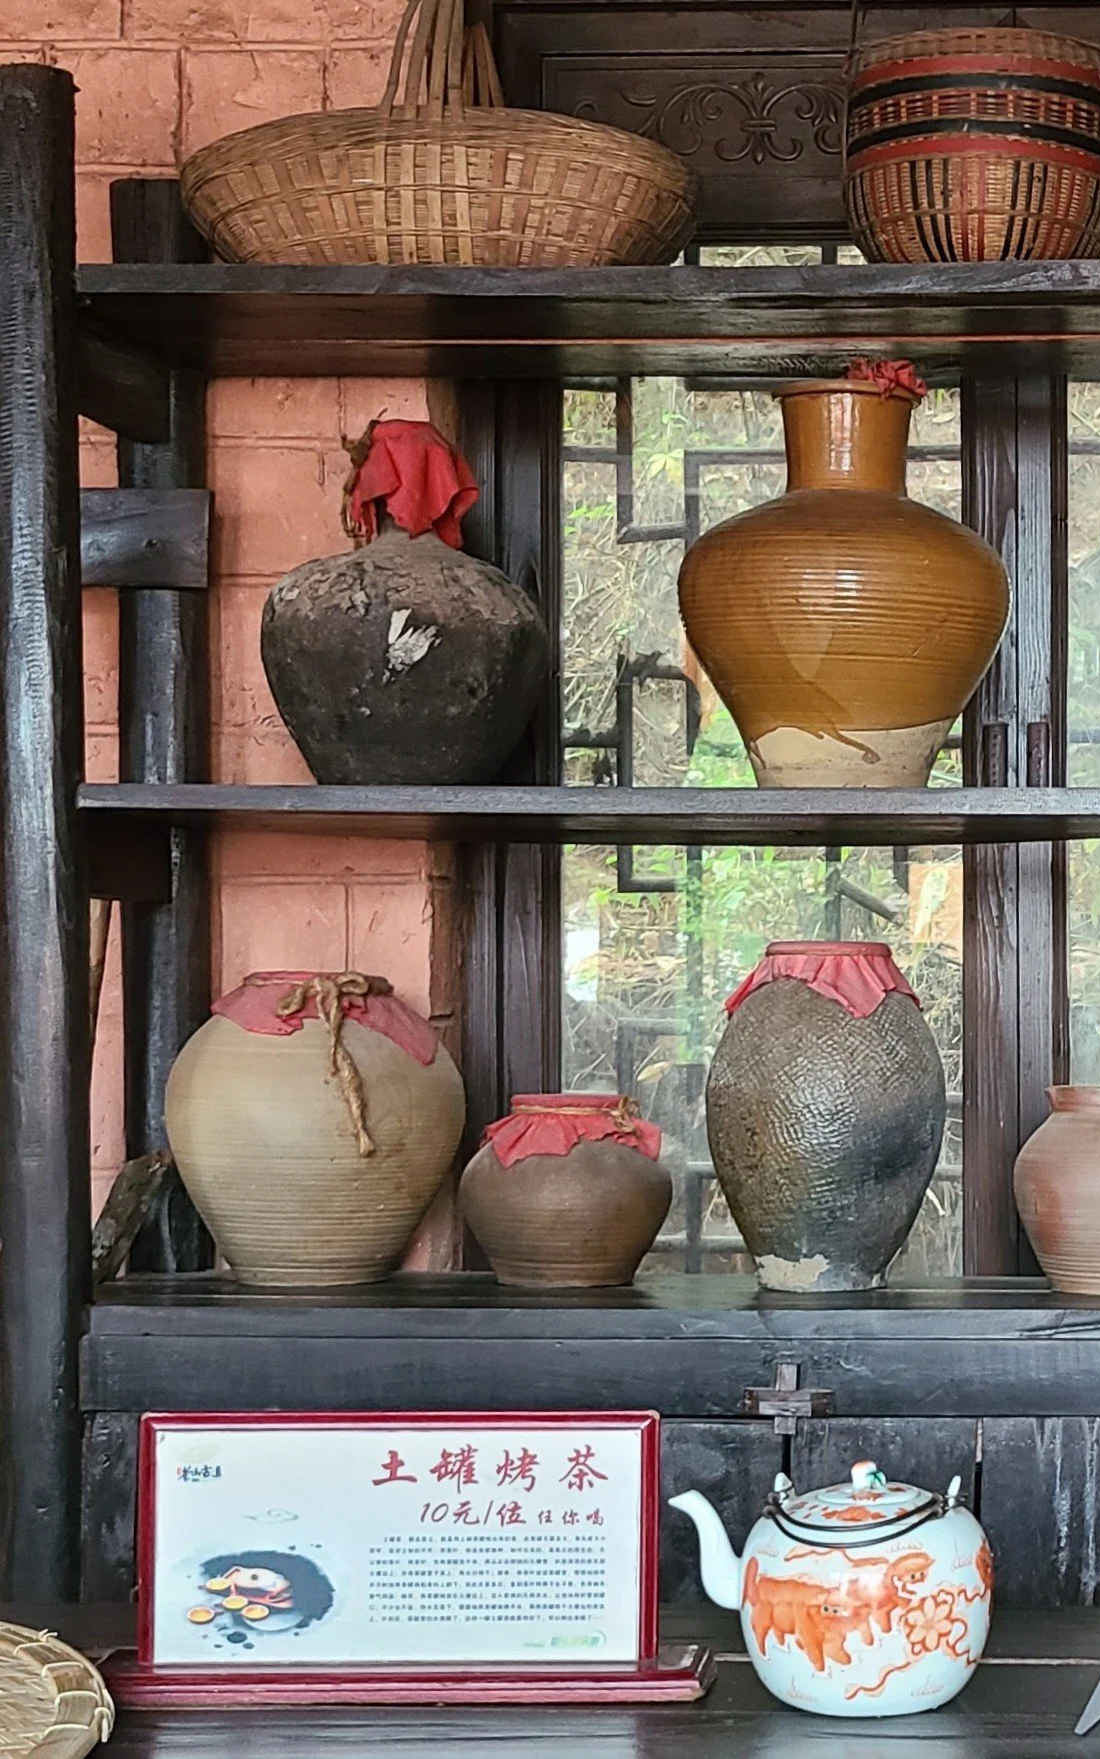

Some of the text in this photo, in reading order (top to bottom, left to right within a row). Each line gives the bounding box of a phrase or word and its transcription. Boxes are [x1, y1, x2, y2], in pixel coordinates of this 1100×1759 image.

[371, 1443, 609, 1494] 土罐烤茶
[537, 1508, 604, 1527] 任你喝
